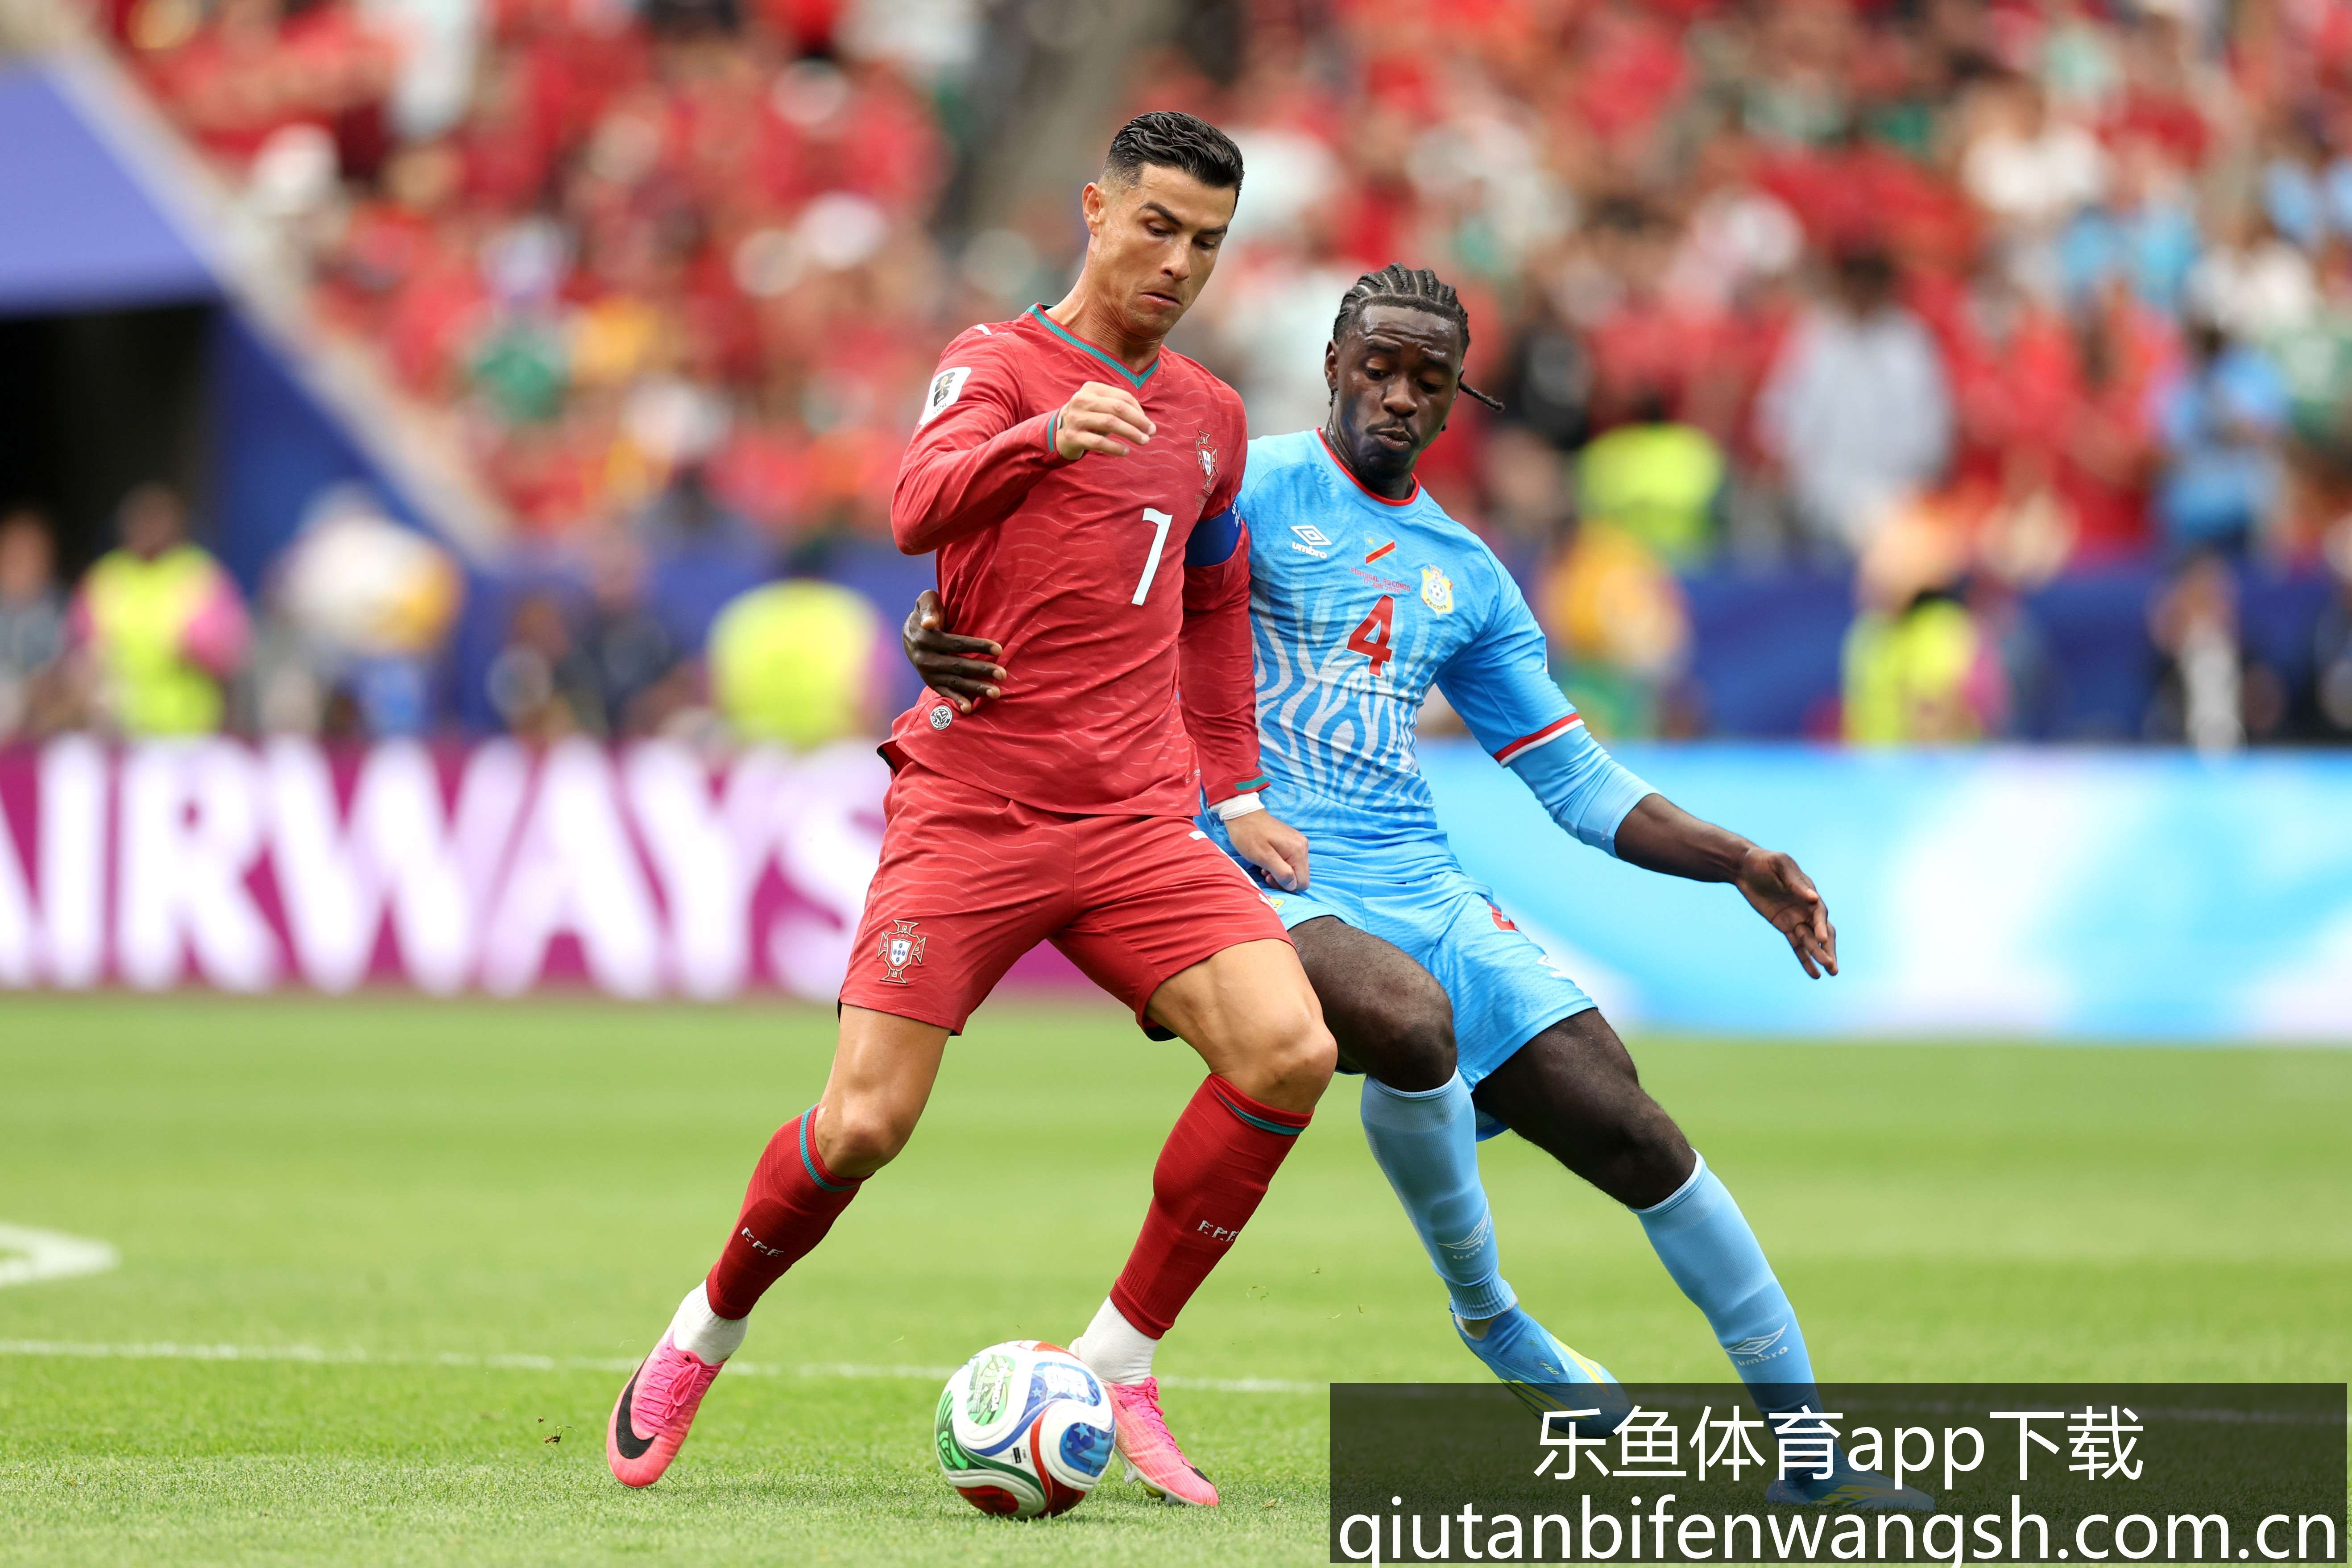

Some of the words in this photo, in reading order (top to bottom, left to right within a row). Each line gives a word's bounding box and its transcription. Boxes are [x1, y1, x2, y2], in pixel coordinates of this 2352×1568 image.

[1131, 508, 1173, 606] 7
[1292, 542, 1328, 559] umbro
[1351, 567, 1379, 583] PORTUGAL
[1392, 581, 1411, 592] CONGO
[1372, 582, 1383, 590] JUIN
[1346, 594, 1395, 678] 4
[1540, 1363, 1560, 1375] F50
[990, 1362, 1010, 1412] TONDA
